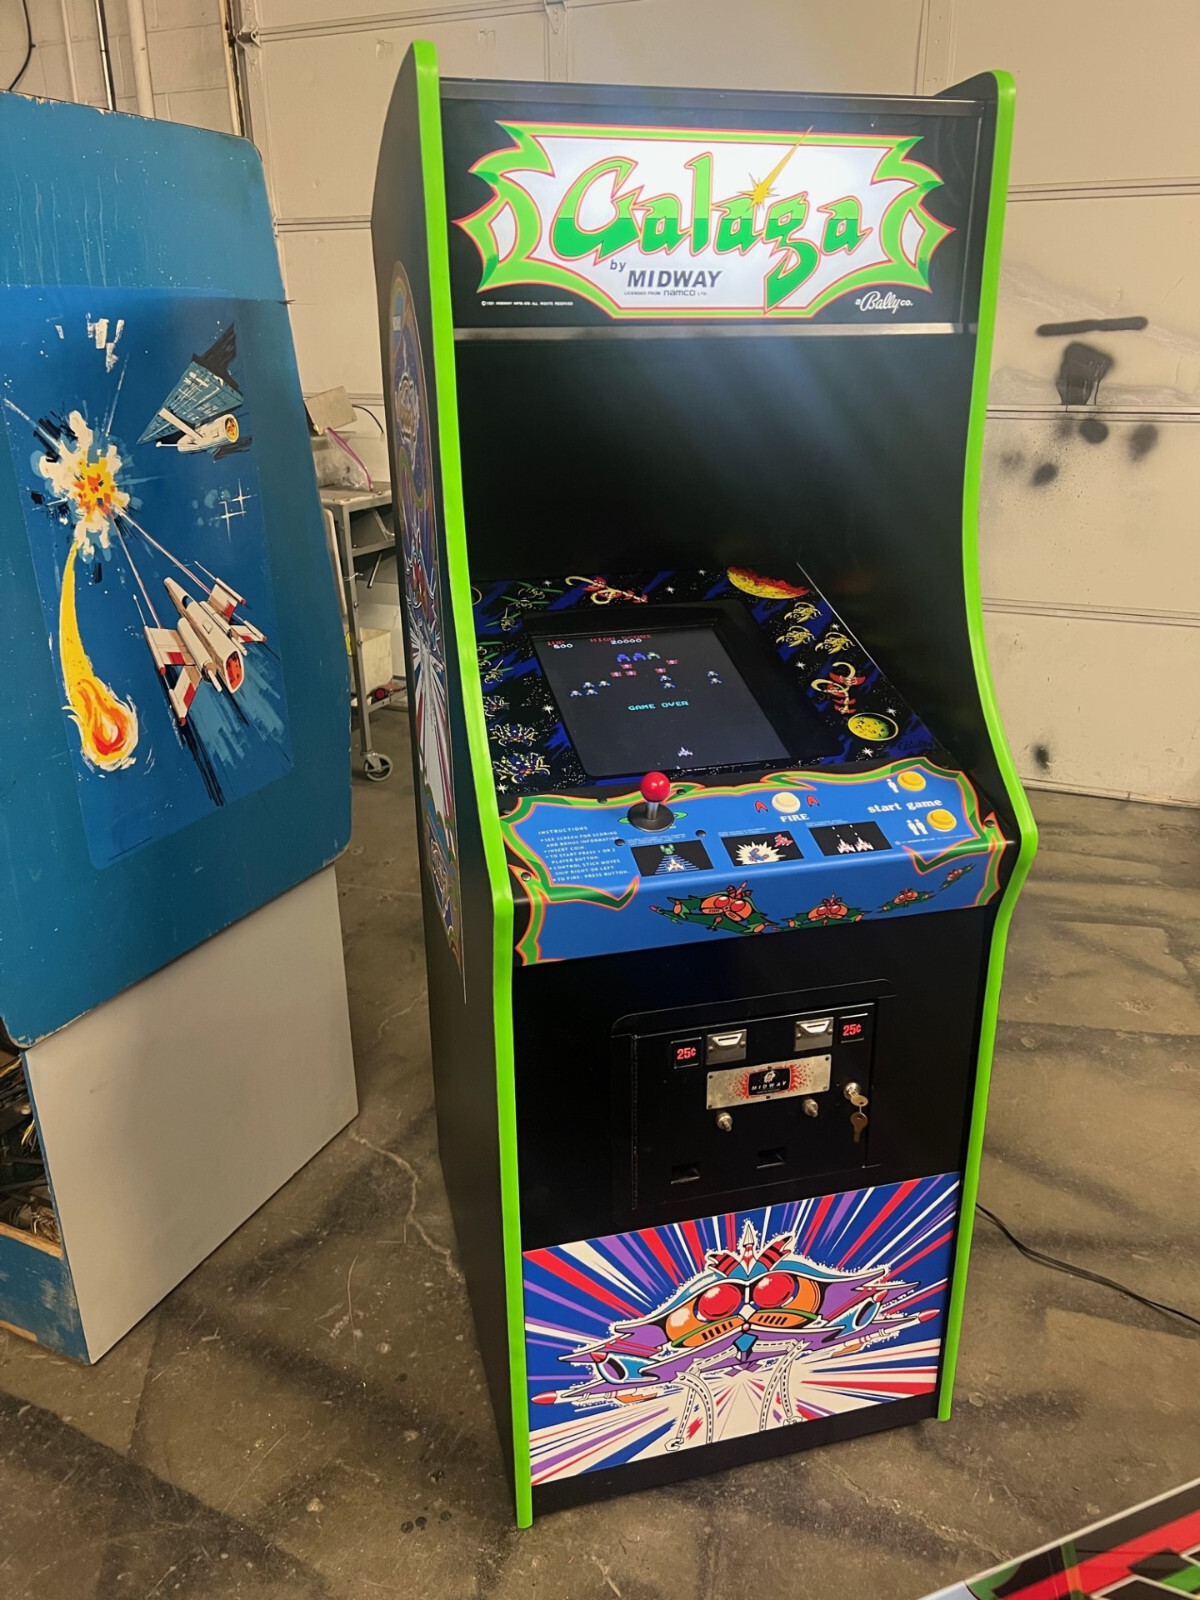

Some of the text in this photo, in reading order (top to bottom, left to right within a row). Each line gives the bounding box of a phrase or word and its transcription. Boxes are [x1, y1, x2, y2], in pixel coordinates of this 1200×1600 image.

[552, 152, 873, 315] Galaga
[609, 259, 627, 272] by
[627, 270, 722, 288] MIDWAY
[860, 290, 901, 314] Bally
[590, 636, 616, 644] HIGH
[628, 700, 689, 711] GAME OVER
[867, 799, 943, 814] start game
[779, 813, 810, 823] FIRE
[538, 826, 588, 835] INSTRUCTIONS
[842, 1023, 862, 1037] 25¢
[676, 1047, 697, 1060] 25¢
[751, 1080, 787, 1091] MIDWAY
